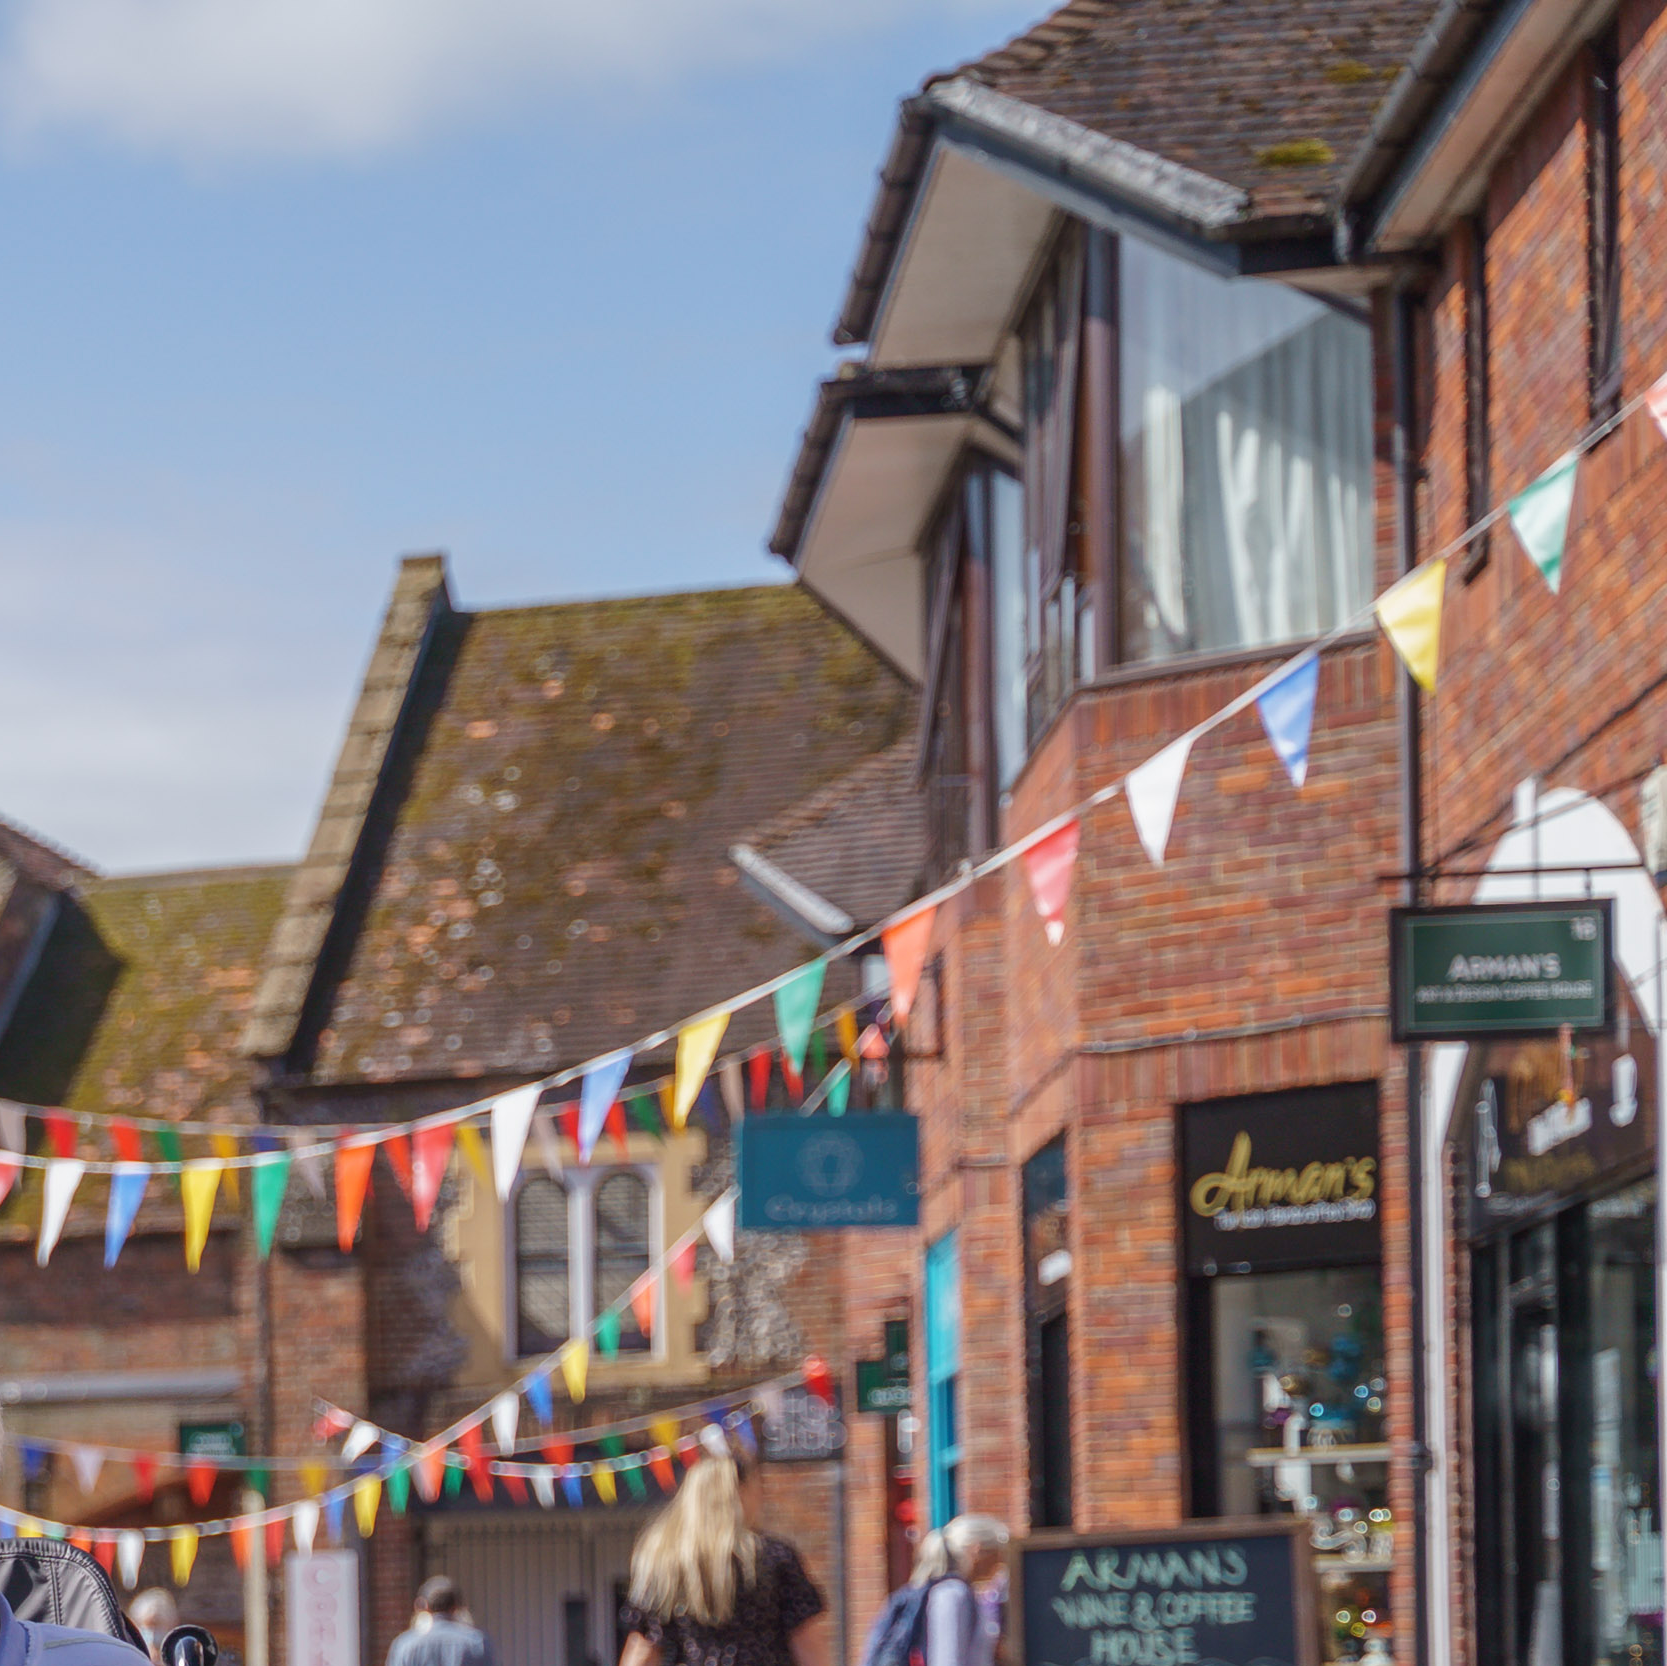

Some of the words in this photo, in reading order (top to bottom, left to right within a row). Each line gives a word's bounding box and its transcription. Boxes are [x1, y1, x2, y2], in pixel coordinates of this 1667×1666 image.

[1445, 952, 1562, 983] ARMAN'S
[1189, 1129, 1377, 1218] Arman's
[1052, 1592, 1131, 1629] WINE
[1157, 1590, 1258, 1627] COFFEE
